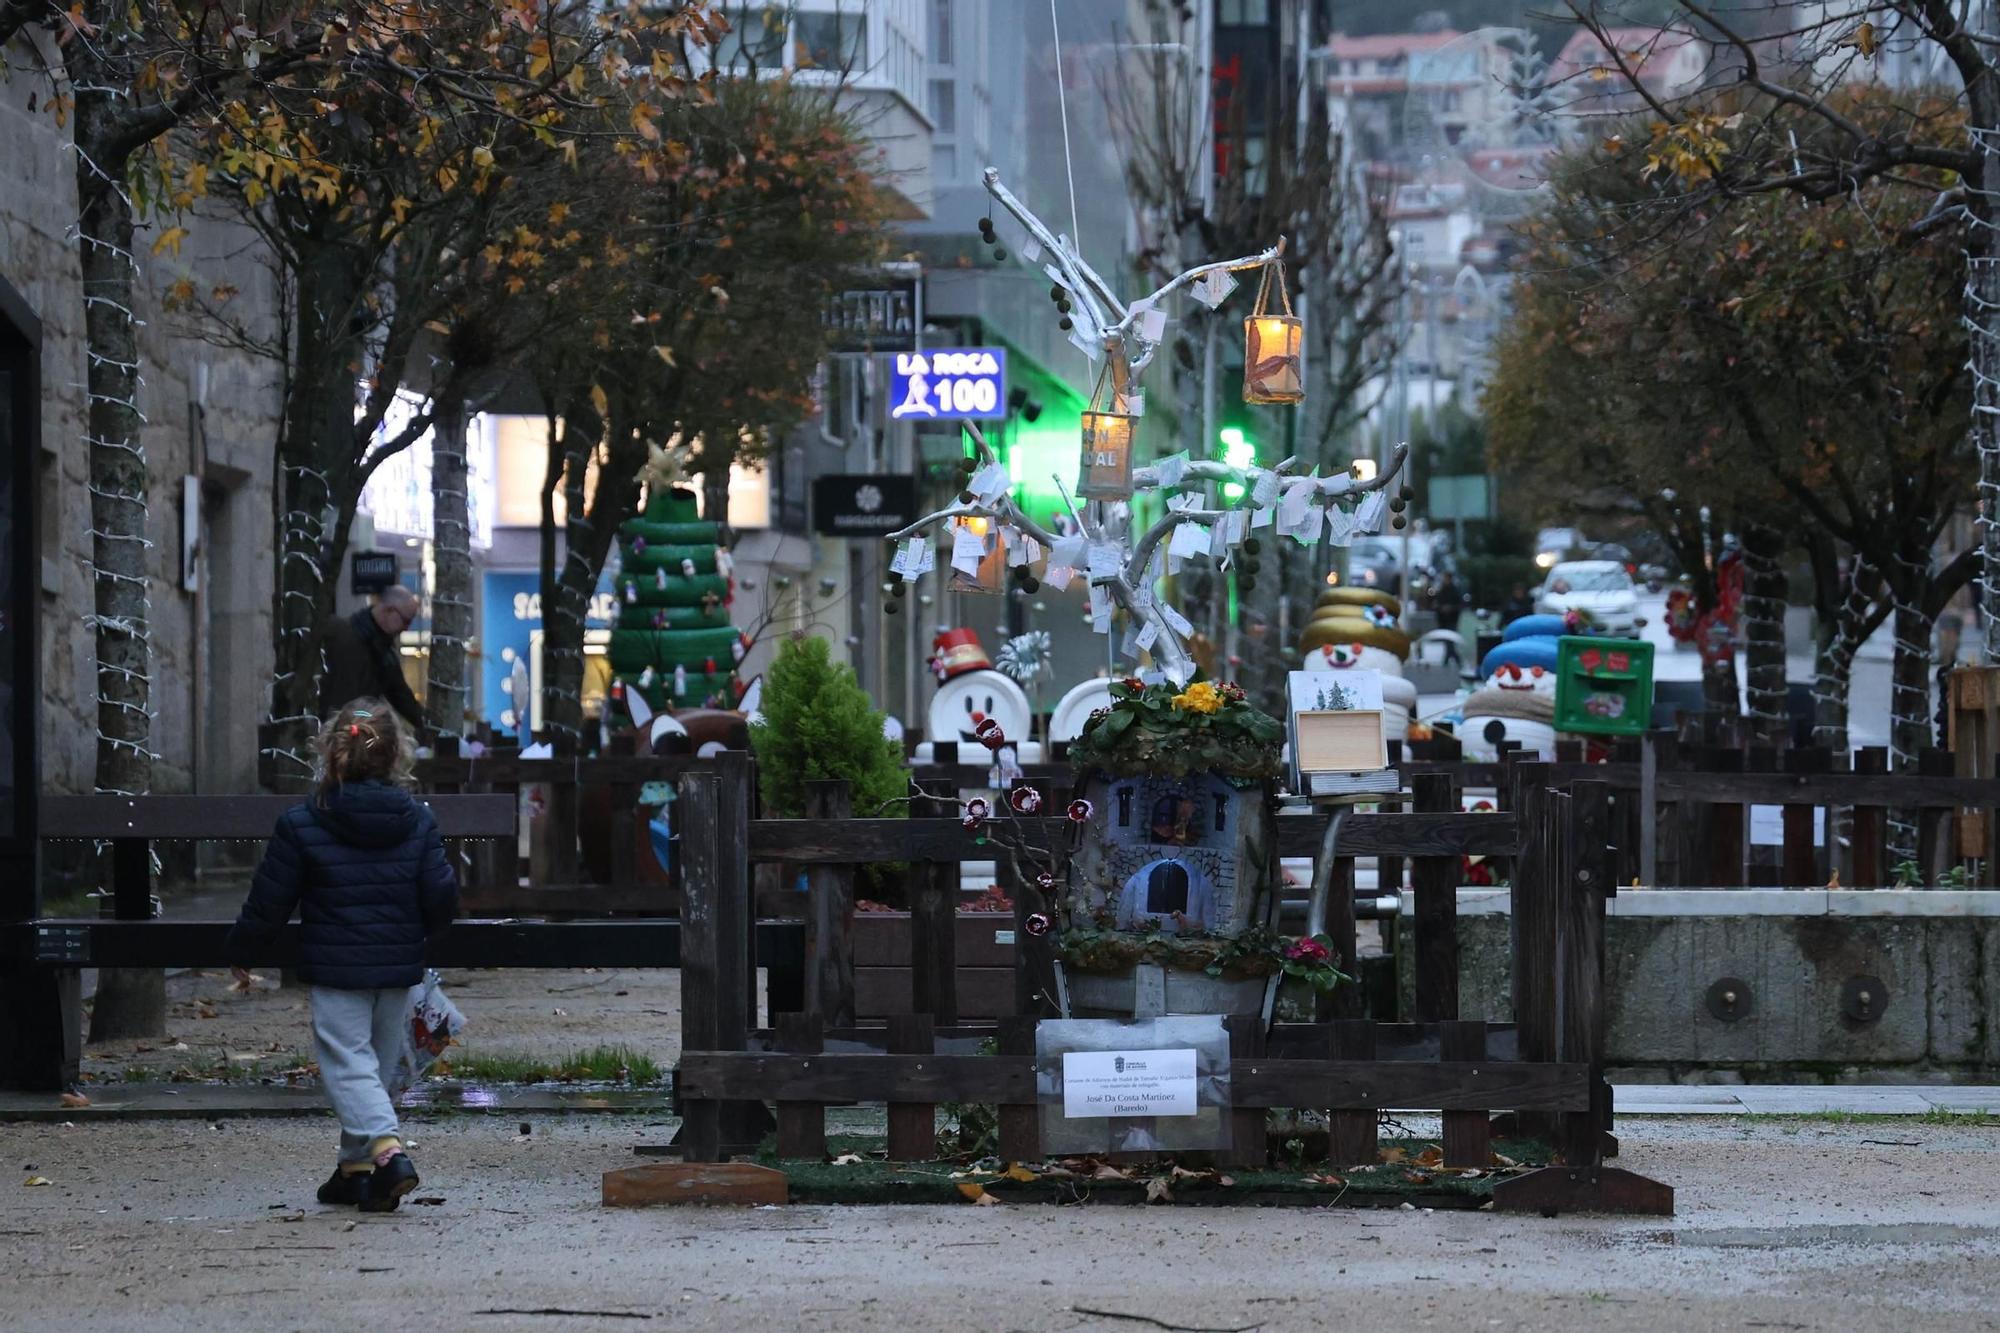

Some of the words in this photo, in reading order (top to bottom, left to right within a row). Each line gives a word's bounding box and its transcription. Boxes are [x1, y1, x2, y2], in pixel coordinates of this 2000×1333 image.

[896, 353, 930, 376] LA
[934, 378, 996, 412] 100
[1086, 1094, 1103, 1103] José
[1104, 1094, 1116, 1102] Da
[1117, 1094, 1139, 1102] Costa
[1114, 1104, 1148, 1113] (Baredo)
